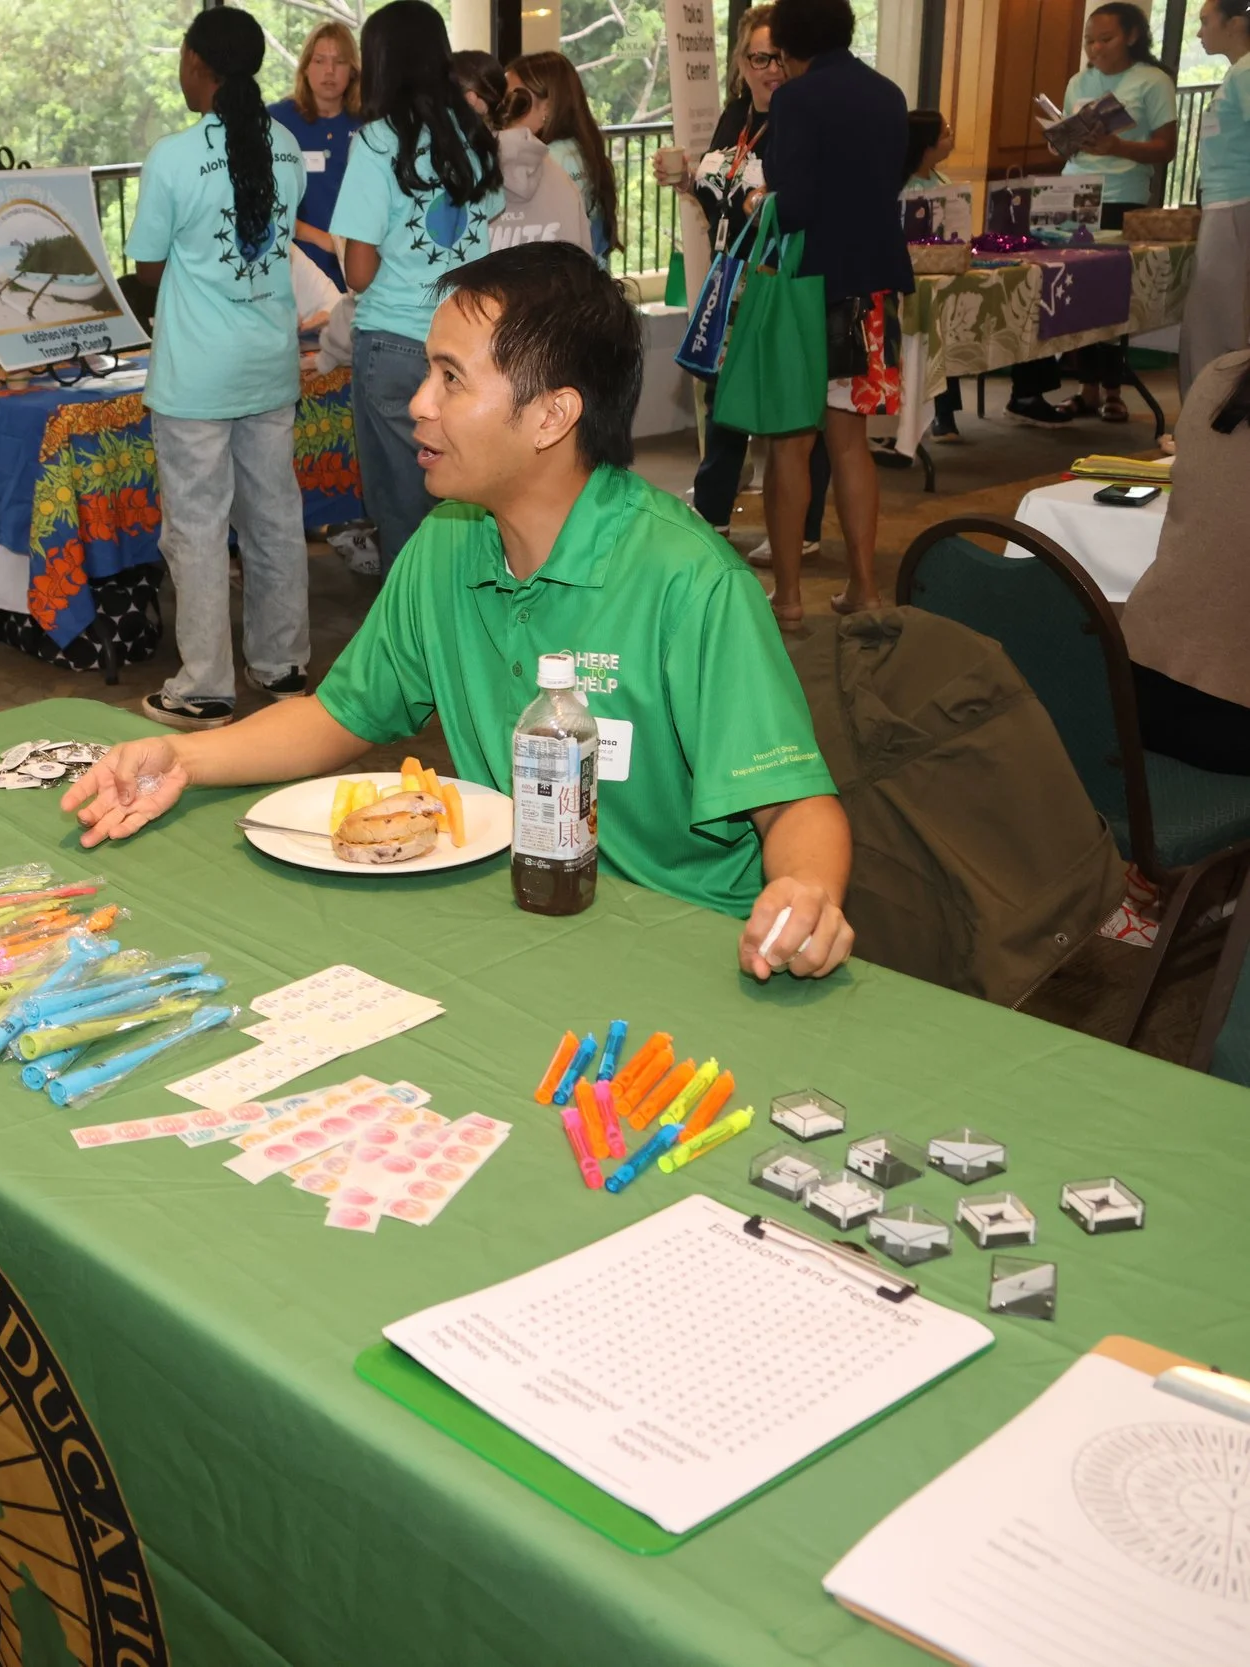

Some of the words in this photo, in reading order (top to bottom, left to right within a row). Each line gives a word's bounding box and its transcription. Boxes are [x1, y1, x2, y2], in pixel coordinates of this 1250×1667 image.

[200, 158, 228, 176] Aloh
[575, 651, 620, 670] HERE
[587, 667, 606, 679] TO
[574, 676, 618, 694] HELP
[708, 1222, 795, 1267] Emotions
[797, 1265, 838, 1286] and
[840, 1284, 922, 1327] Feelings
